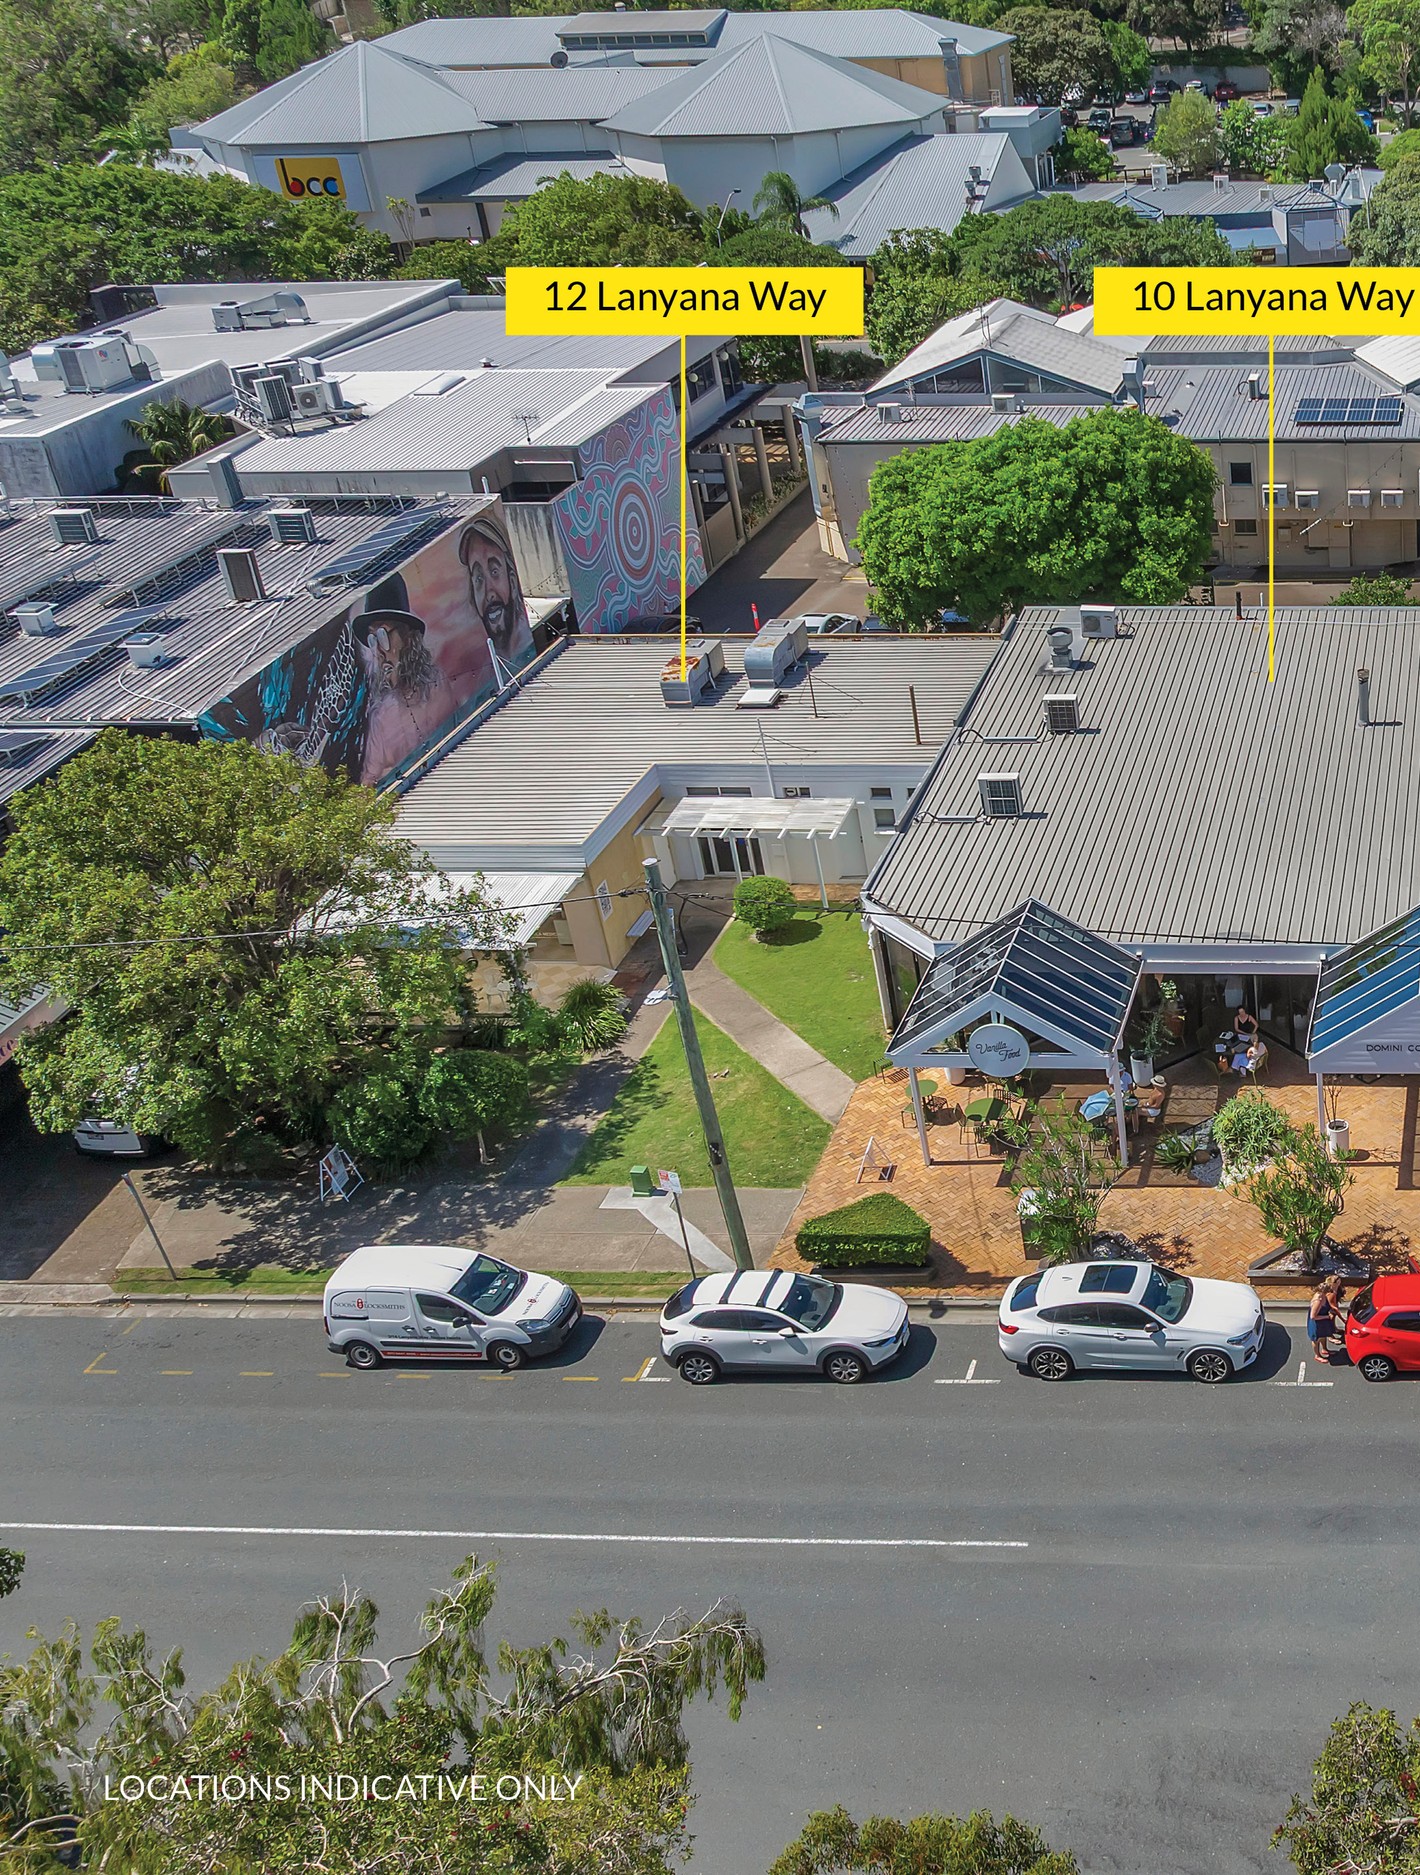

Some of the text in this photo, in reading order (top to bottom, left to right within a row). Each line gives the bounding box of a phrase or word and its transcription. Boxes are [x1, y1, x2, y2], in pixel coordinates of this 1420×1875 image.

[279, 158, 341, 197] bcc
[975, 1041, 1007, 1054] Vanilla
[1366, 1044, 1403, 1052] DOMINI
[998, 1048, 1021, 1062] Food
[334, 1301, 357, 1309] NOOSA
